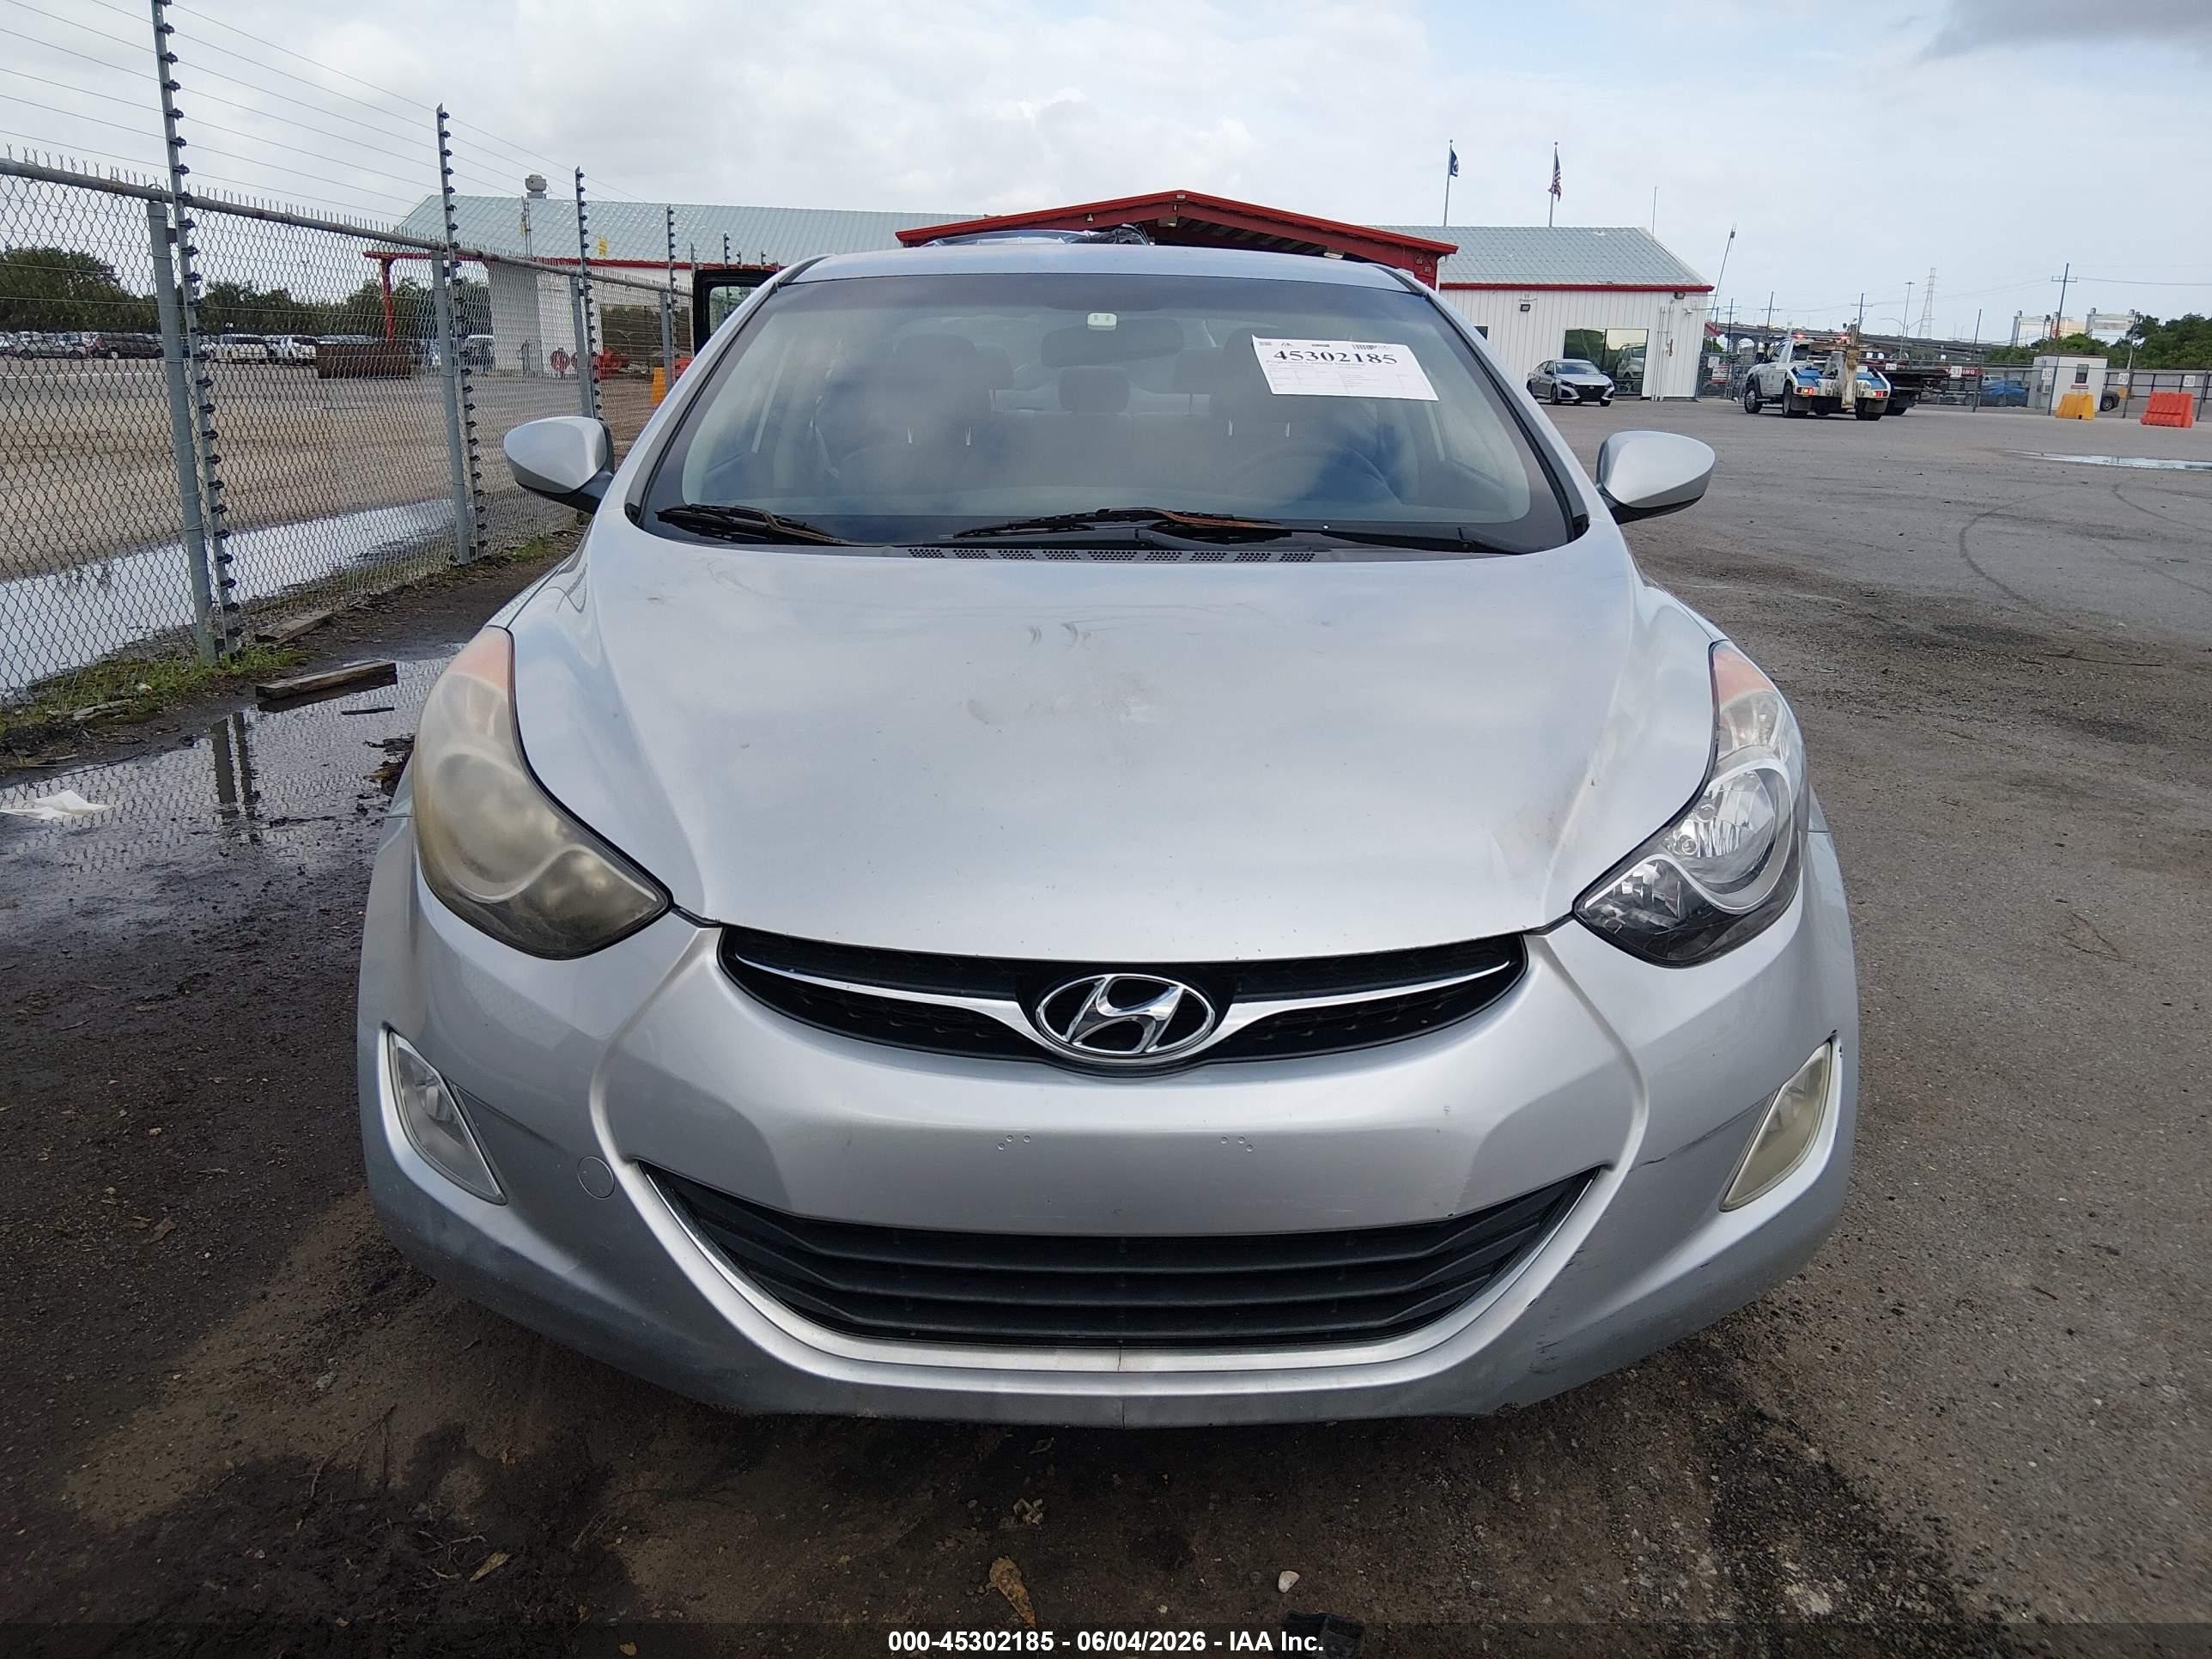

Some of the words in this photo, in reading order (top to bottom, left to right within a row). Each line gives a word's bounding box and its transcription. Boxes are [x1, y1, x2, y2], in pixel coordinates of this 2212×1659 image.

[1273, 349, 1398, 365] 45302185
[2043, 370, 2052, 379] 30
[2185, 377, 2195, 386] 28
